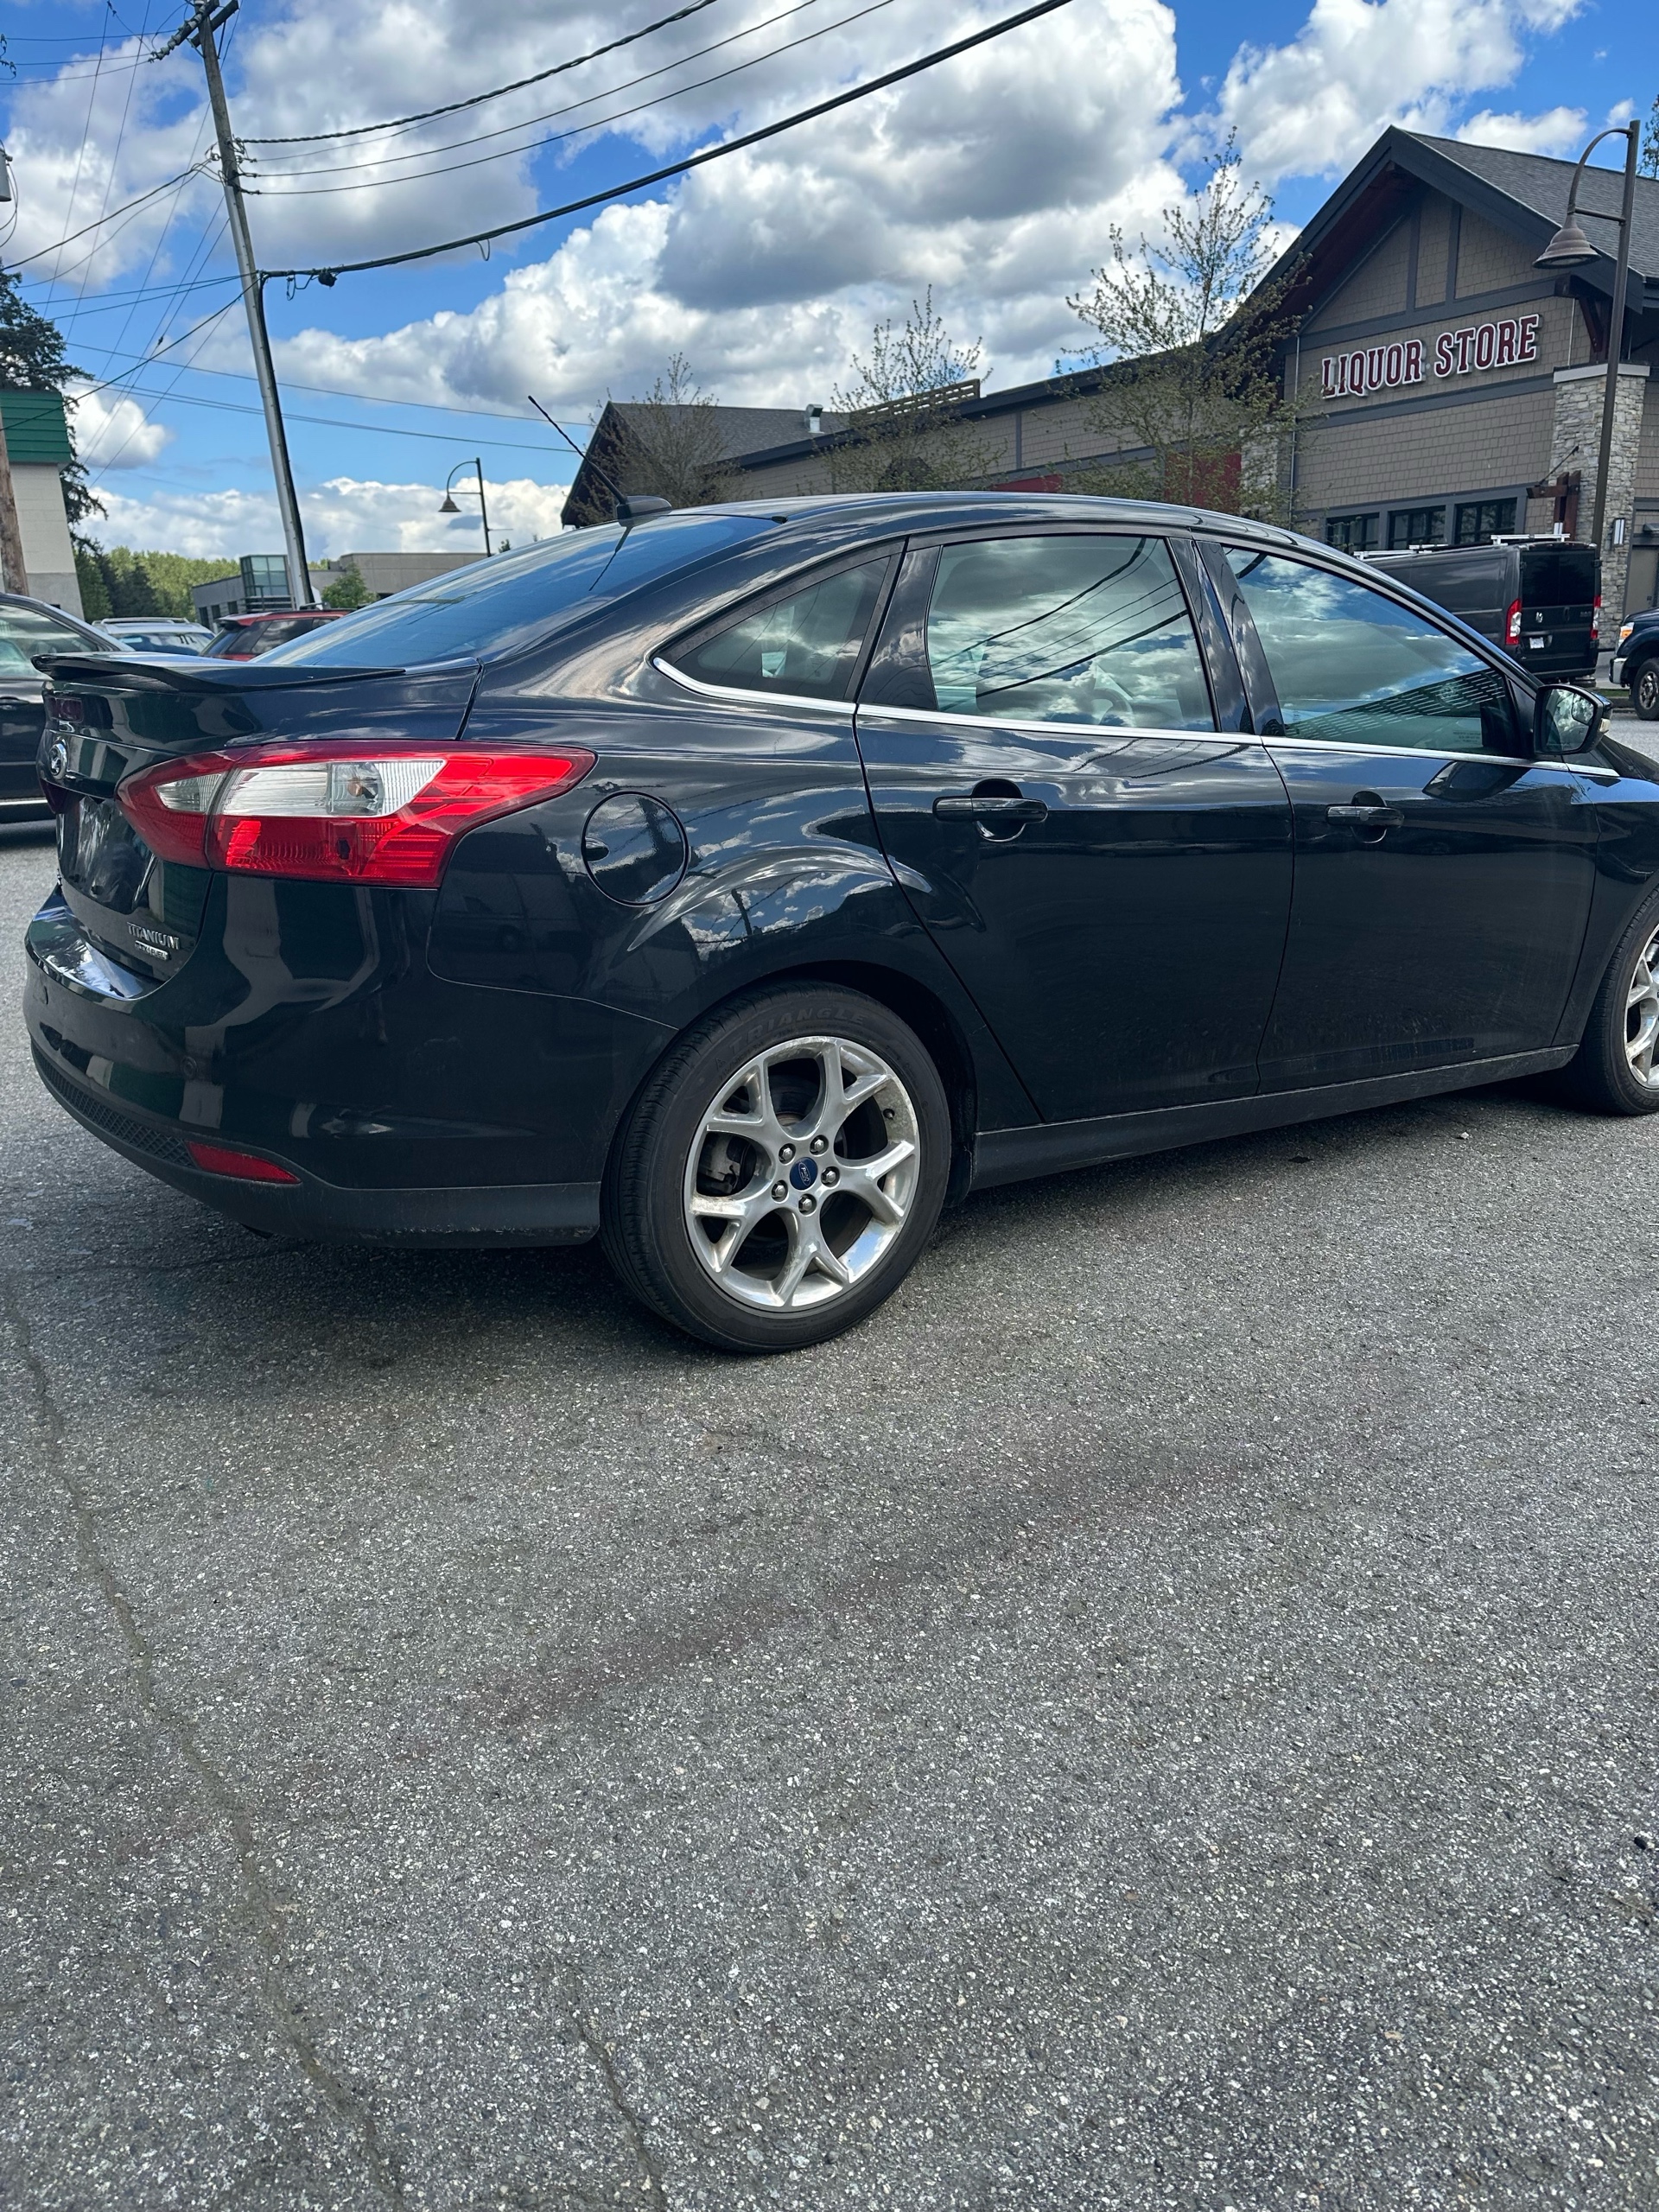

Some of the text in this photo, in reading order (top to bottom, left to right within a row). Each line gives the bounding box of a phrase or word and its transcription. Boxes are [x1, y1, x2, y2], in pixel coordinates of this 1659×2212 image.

[1321, 314, 1540, 398] LIQUOR STORE
[127, 921, 179, 950] TITANIUM
[729, 1007, 868, 1052] TRIANGLE
